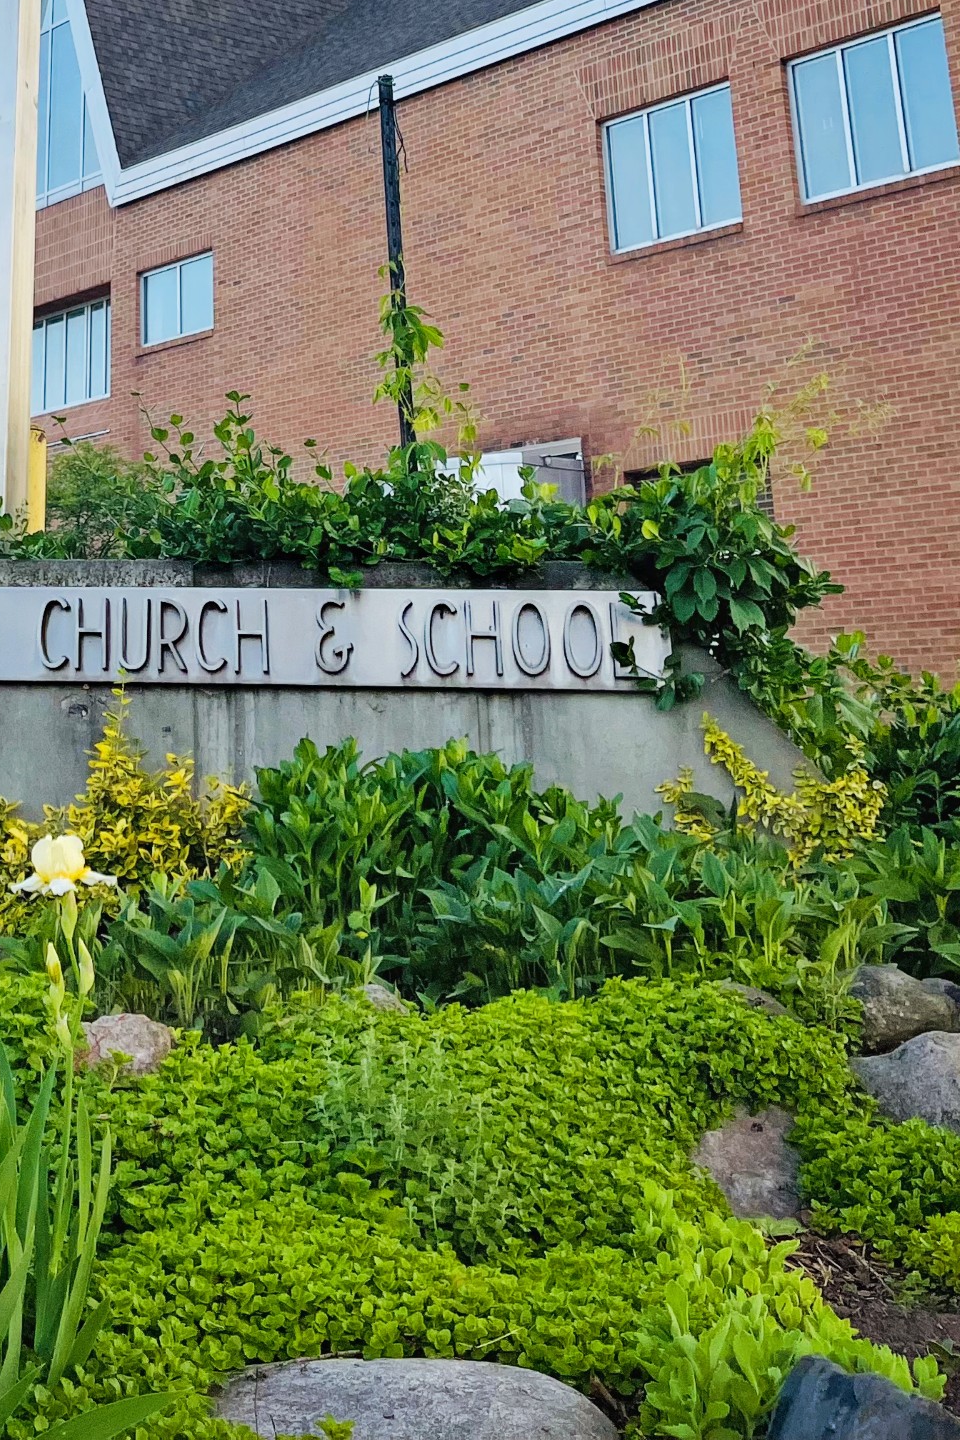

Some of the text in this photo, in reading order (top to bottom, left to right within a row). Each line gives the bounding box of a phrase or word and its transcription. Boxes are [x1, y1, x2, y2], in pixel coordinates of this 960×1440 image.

[40, 596, 271, 674] CHURCH
[314, 601, 354, 675] &
[398, 598, 656, 679] SCHOOL
